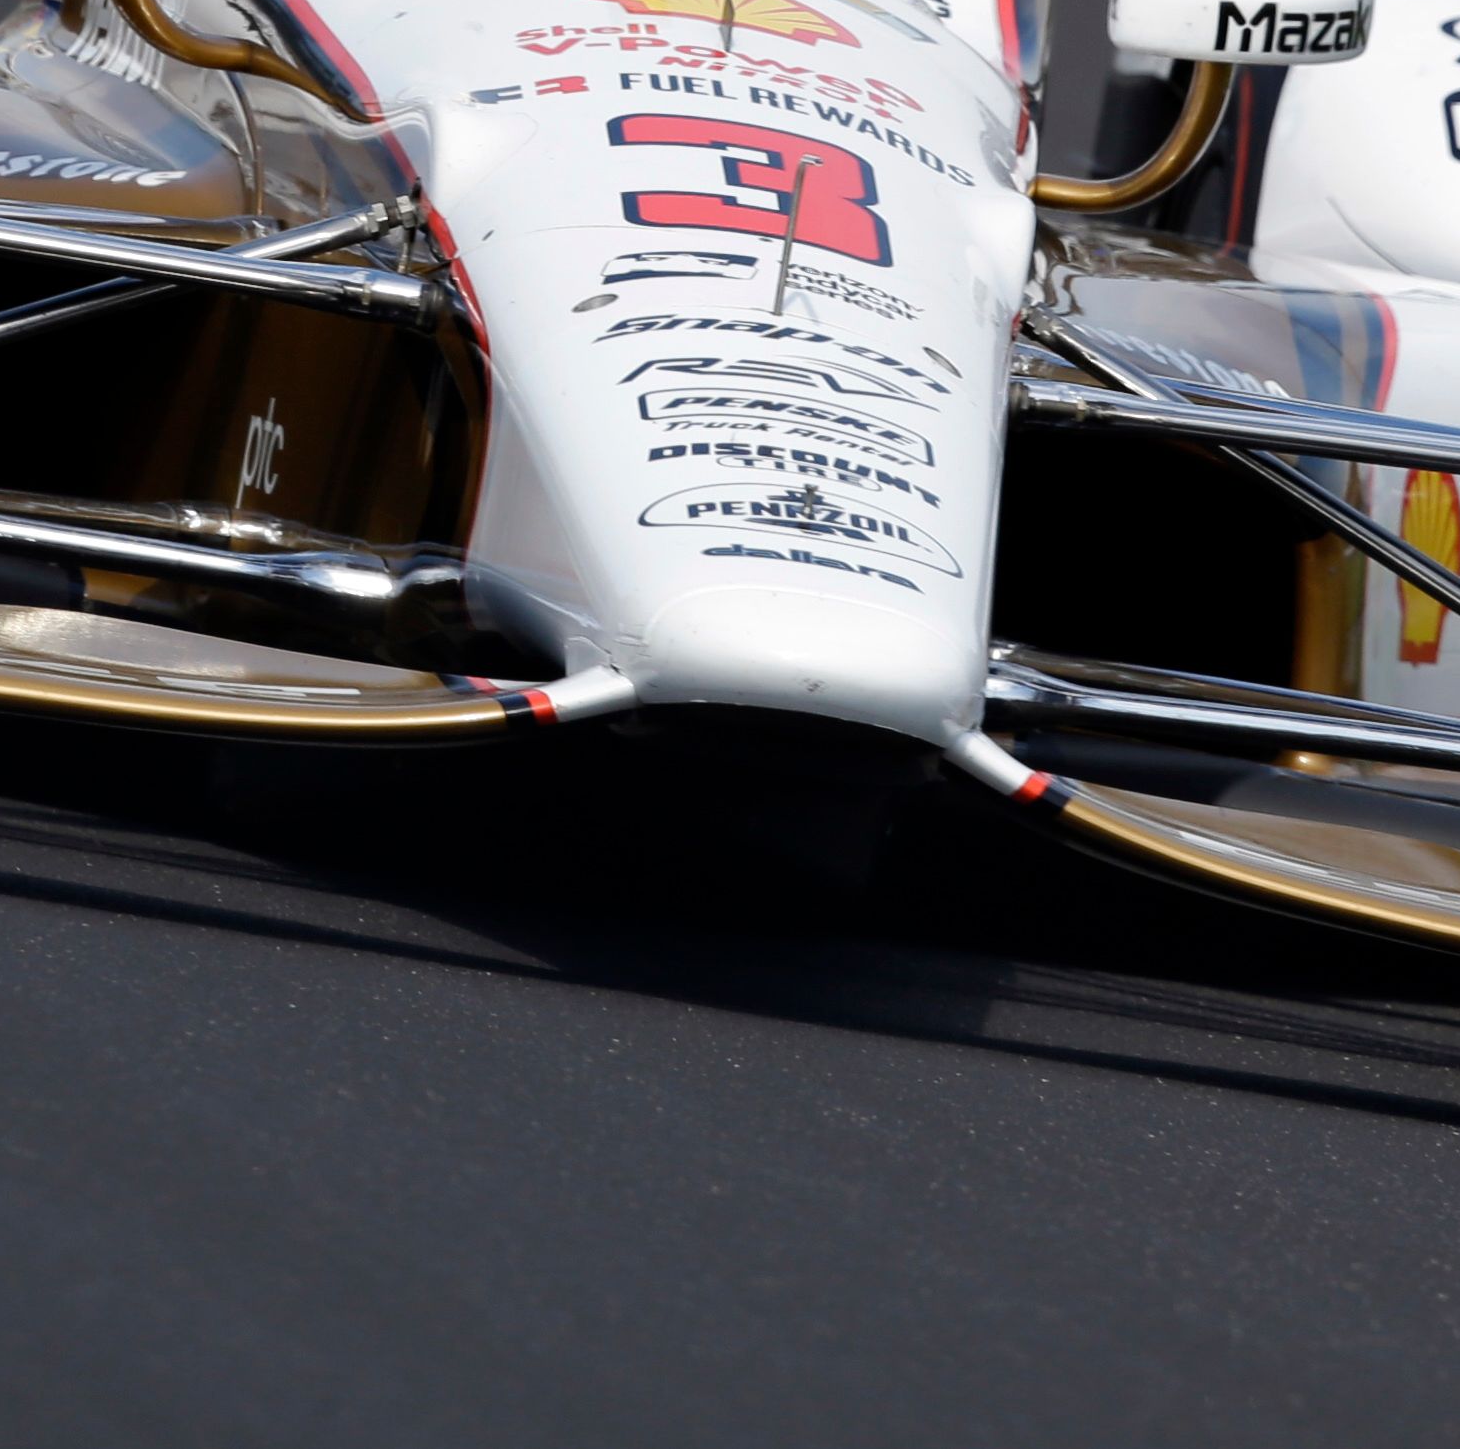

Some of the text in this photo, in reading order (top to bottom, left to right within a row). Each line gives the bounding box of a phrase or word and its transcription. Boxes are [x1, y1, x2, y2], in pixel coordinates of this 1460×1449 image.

[515, 23, 659, 42] Shell
[619, 72, 738, 99] FUEL
[749, 86, 977, 187] REWARDS
[606, 113, 894, 268] 3
[788, 273, 920, 321] ndycar
[660, 395, 920, 448] PENSKE
[662, 419, 773, 433] Truck
[235, 396, 285, 510] ptc
[647, 442, 942, 510] DISCOUNT
[740, 457, 864, 488] TIRE
[685, 500, 934, 554] PENNZOIL
[700, 543, 927, 595] dallara
